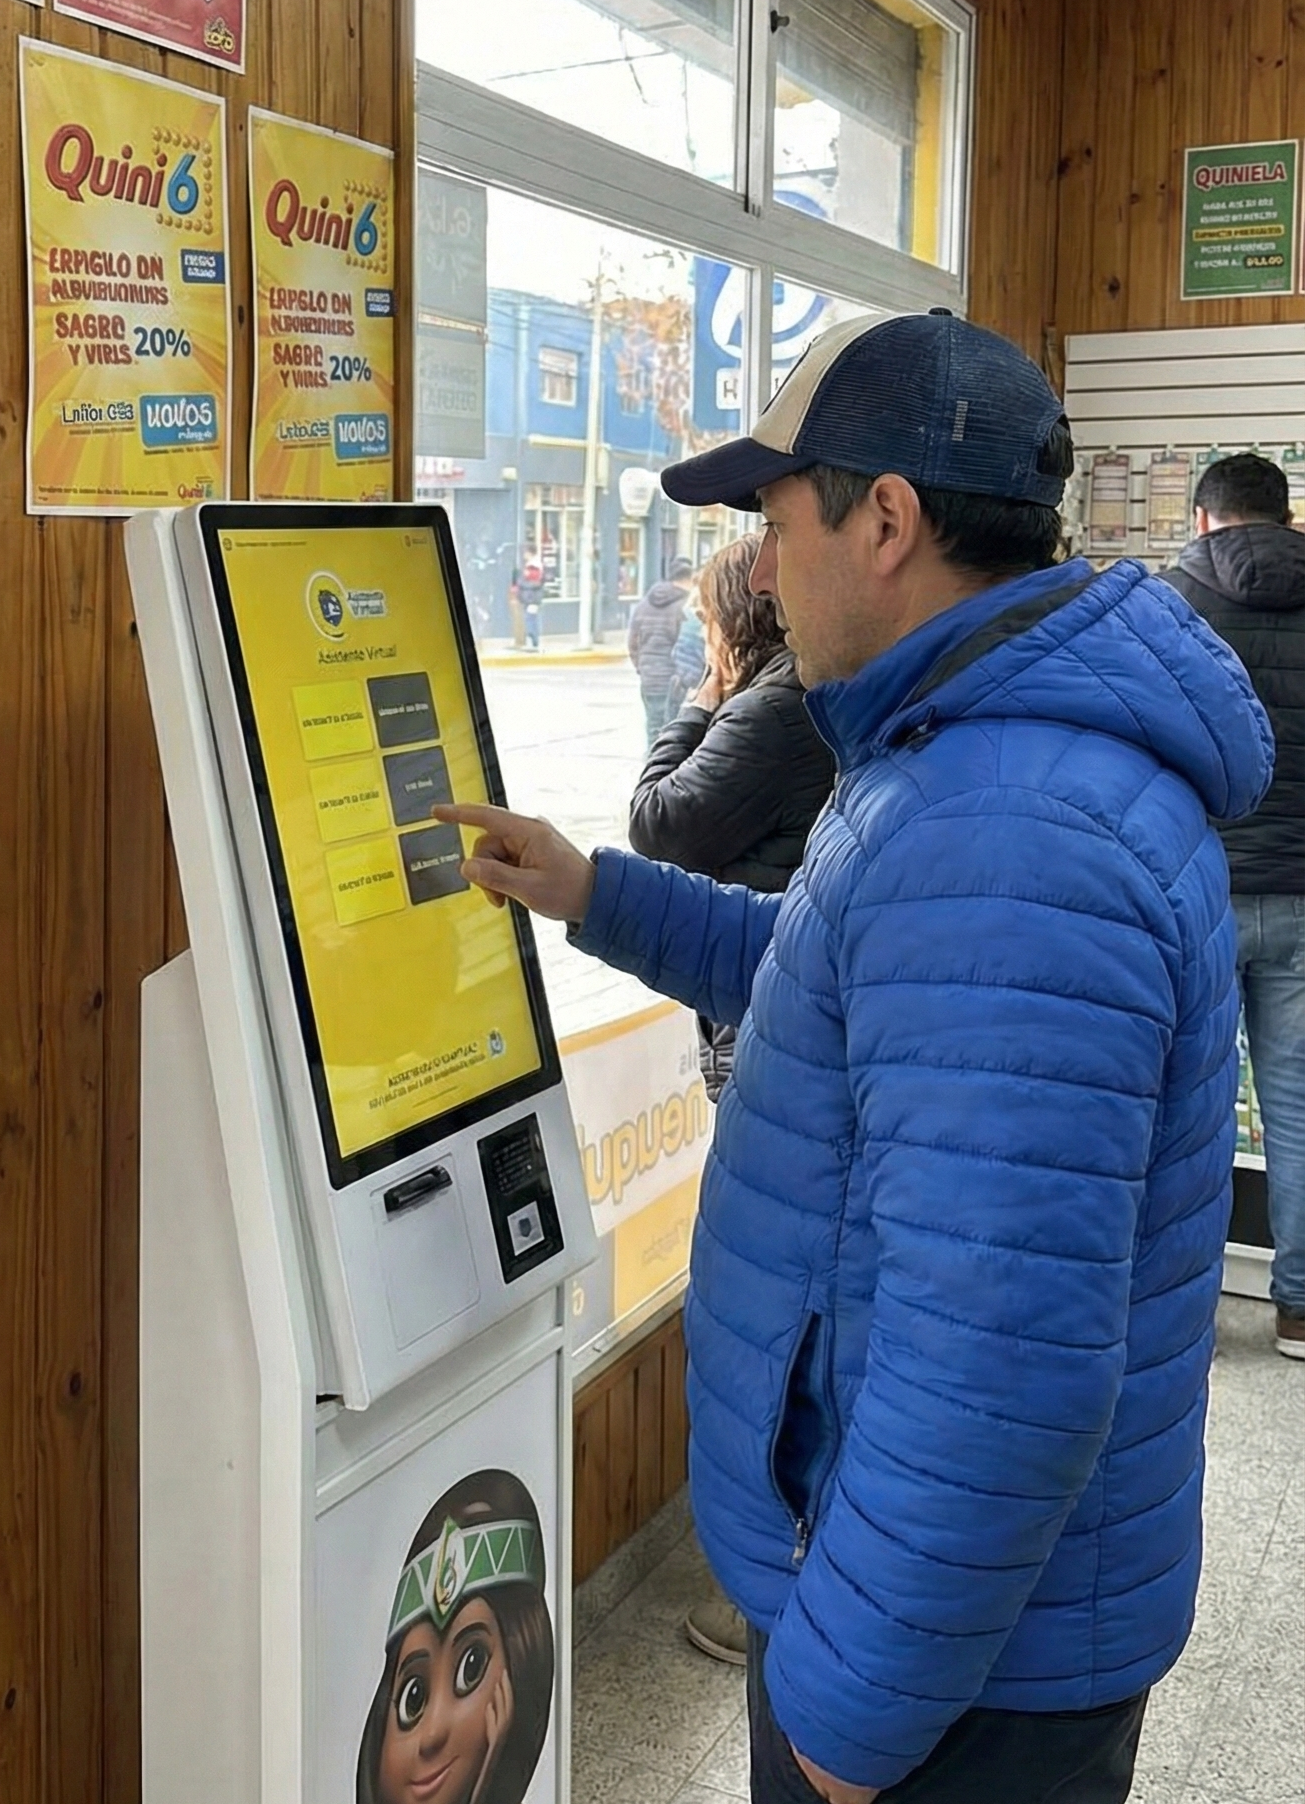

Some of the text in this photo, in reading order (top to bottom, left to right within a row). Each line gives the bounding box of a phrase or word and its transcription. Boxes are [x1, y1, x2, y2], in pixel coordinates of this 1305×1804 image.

[44, 123, 199, 215] Quini 6
[1196, 163, 1285, 190] QUINIELA
[266, 179, 354, 251] Quini
[354, 202, 378, 256] 6
[133, 326, 191, 357] 20%
[329, 355, 372, 382] 20%
